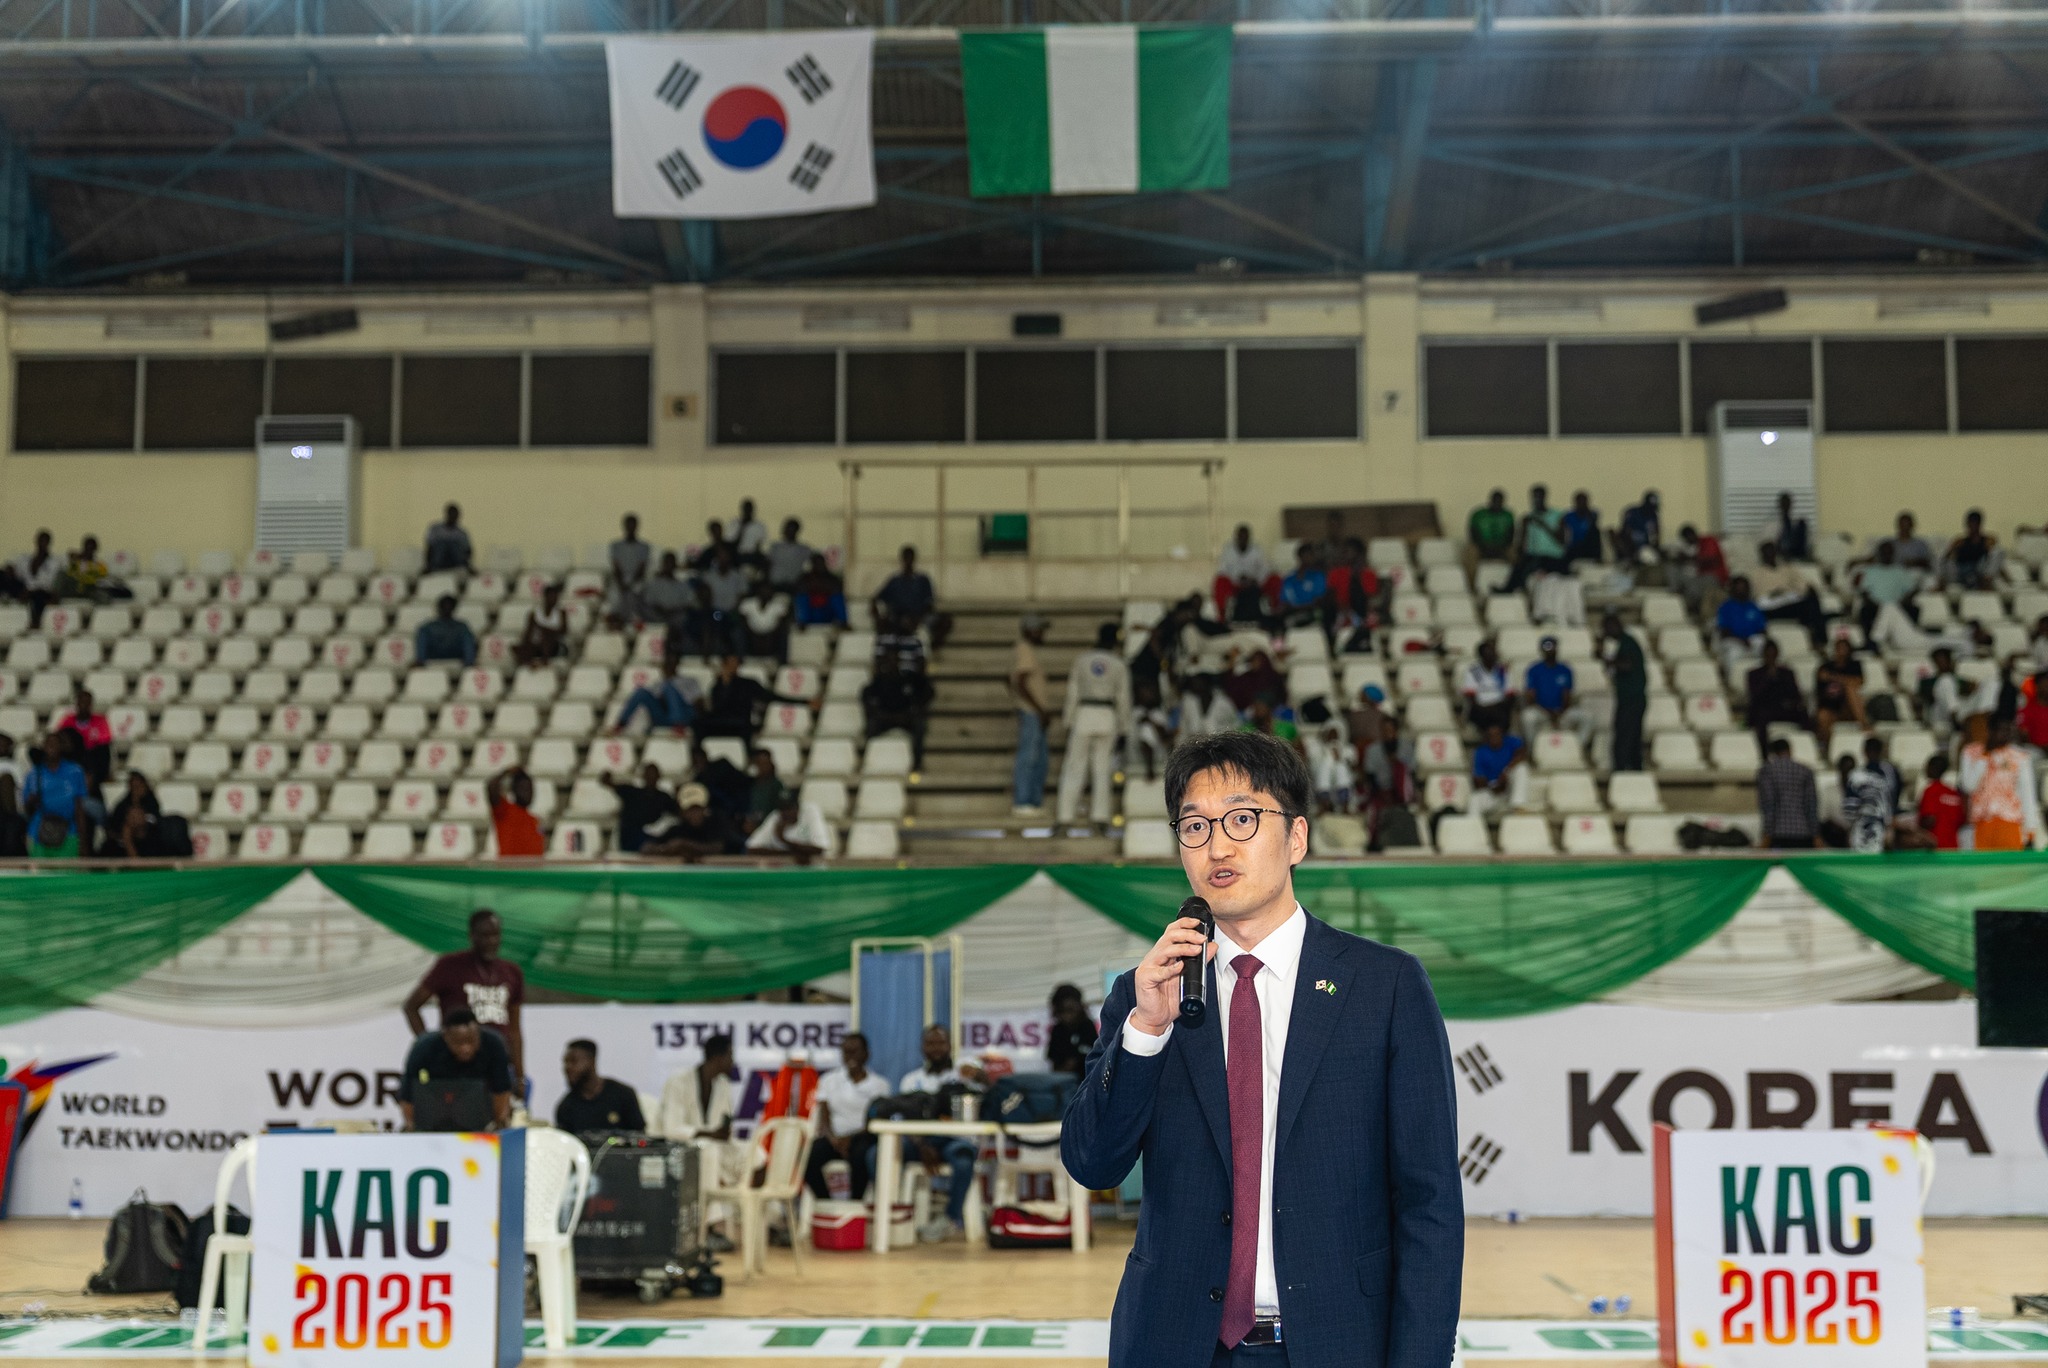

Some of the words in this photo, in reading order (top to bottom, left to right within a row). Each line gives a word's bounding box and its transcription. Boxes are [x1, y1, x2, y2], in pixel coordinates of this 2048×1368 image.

[654, 1022, 734, 1048] 13TH
[749, 1022, 846, 1048] KORE
[60, 1093, 167, 1117] WORLD
[266, 1069, 407, 1108] WOR
[1567, 1068, 1992, 1156] KOREA
[302, 1168, 450, 1259] KAC
[1720, 1164, 1871, 1256] KAC
[293, 1273, 453, 1350] 2025
[750, 1324, 1068, 1349] THE
[1719, 1267, 1881, 1344] 2025
